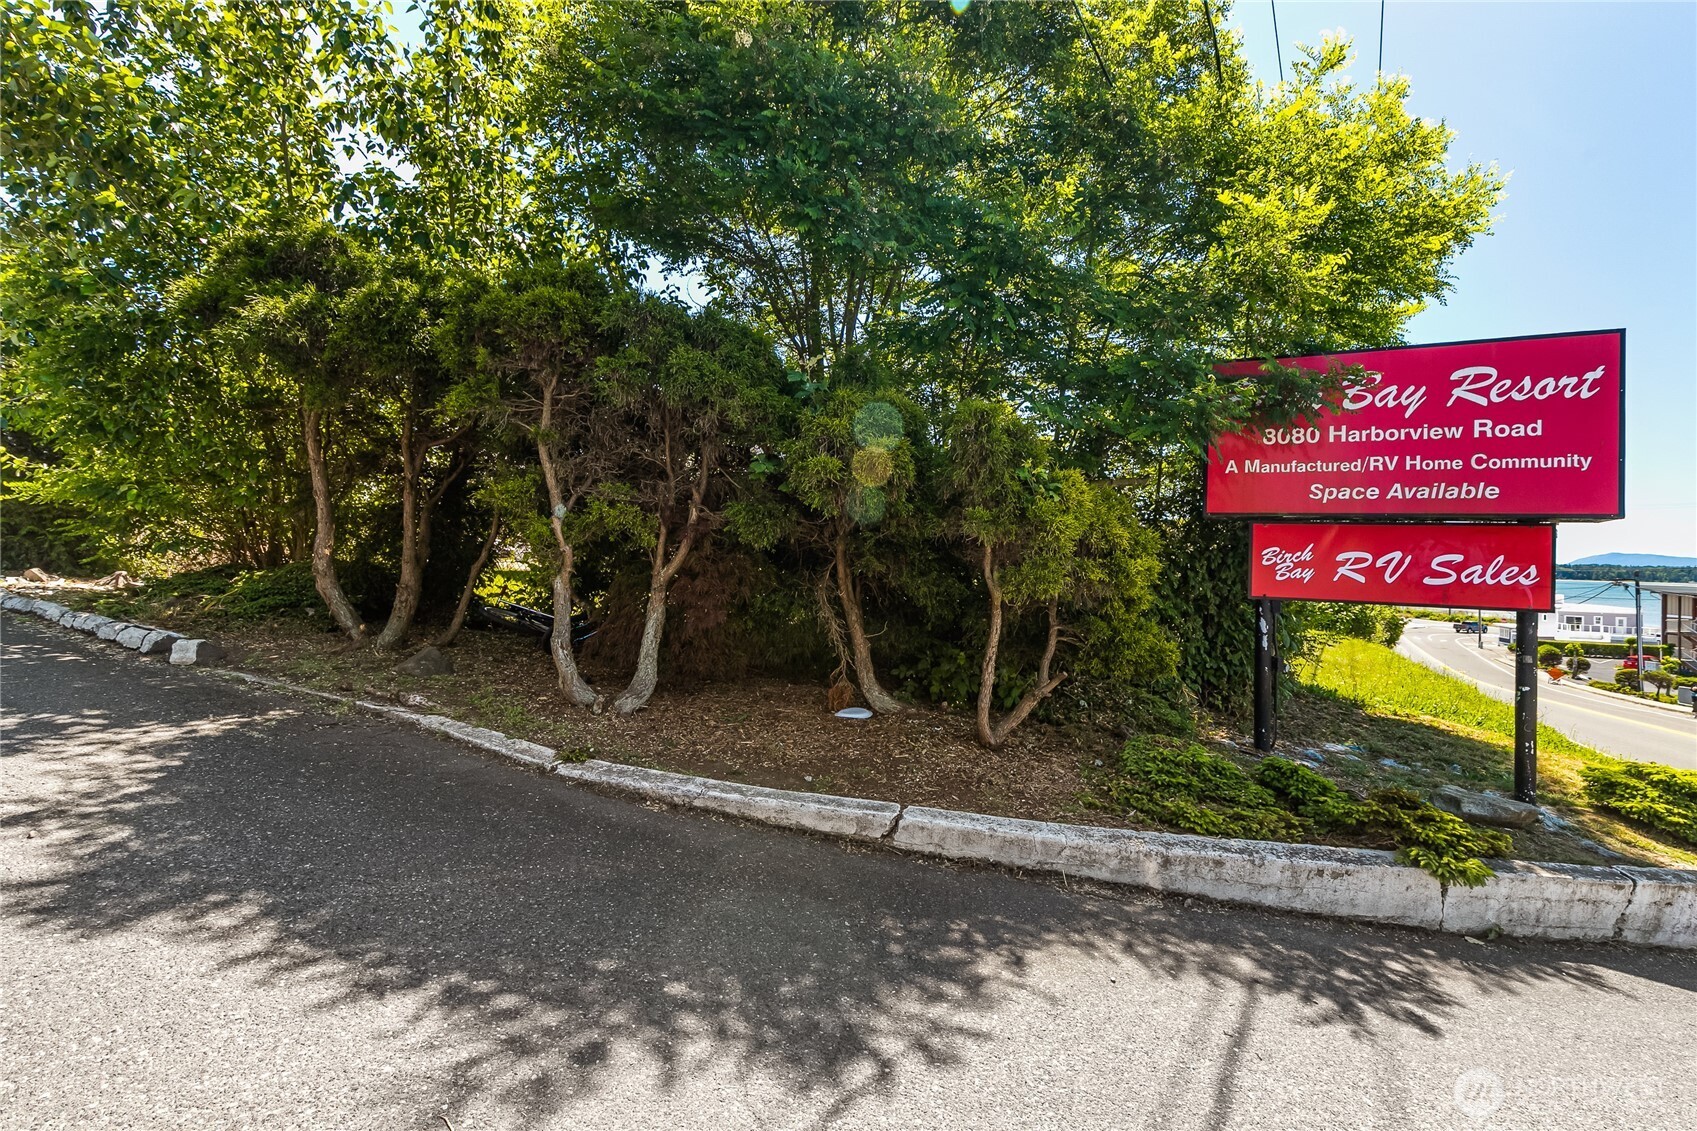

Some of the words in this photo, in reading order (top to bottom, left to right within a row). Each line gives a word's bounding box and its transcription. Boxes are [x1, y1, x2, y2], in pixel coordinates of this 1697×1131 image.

[1341, 370, 1427, 419] Bay
[1446, 365, 1606, 407] Resort
[1262, 427, 1321, 446] 3080
[1328, 424, 1464, 443] Harborview
[1473, 419, 1543, 439] Road
[1224, 459, 1239, 474] A
[1244, 455, 1400, 474] Manufactured/RV
[1405, 455, 1464, 471] Home
[1470, 453, 1593, 471] Community
[1308, 483, 1380, 503] Space
[1386, 481, 1500, 500] Available
[1261, 542, 1315, 567] Birch
[1274, 563, 1316, 584] Bay
[1332, 550, 1413, 585] RV
[1422, 554, 1541, 587] Sales
